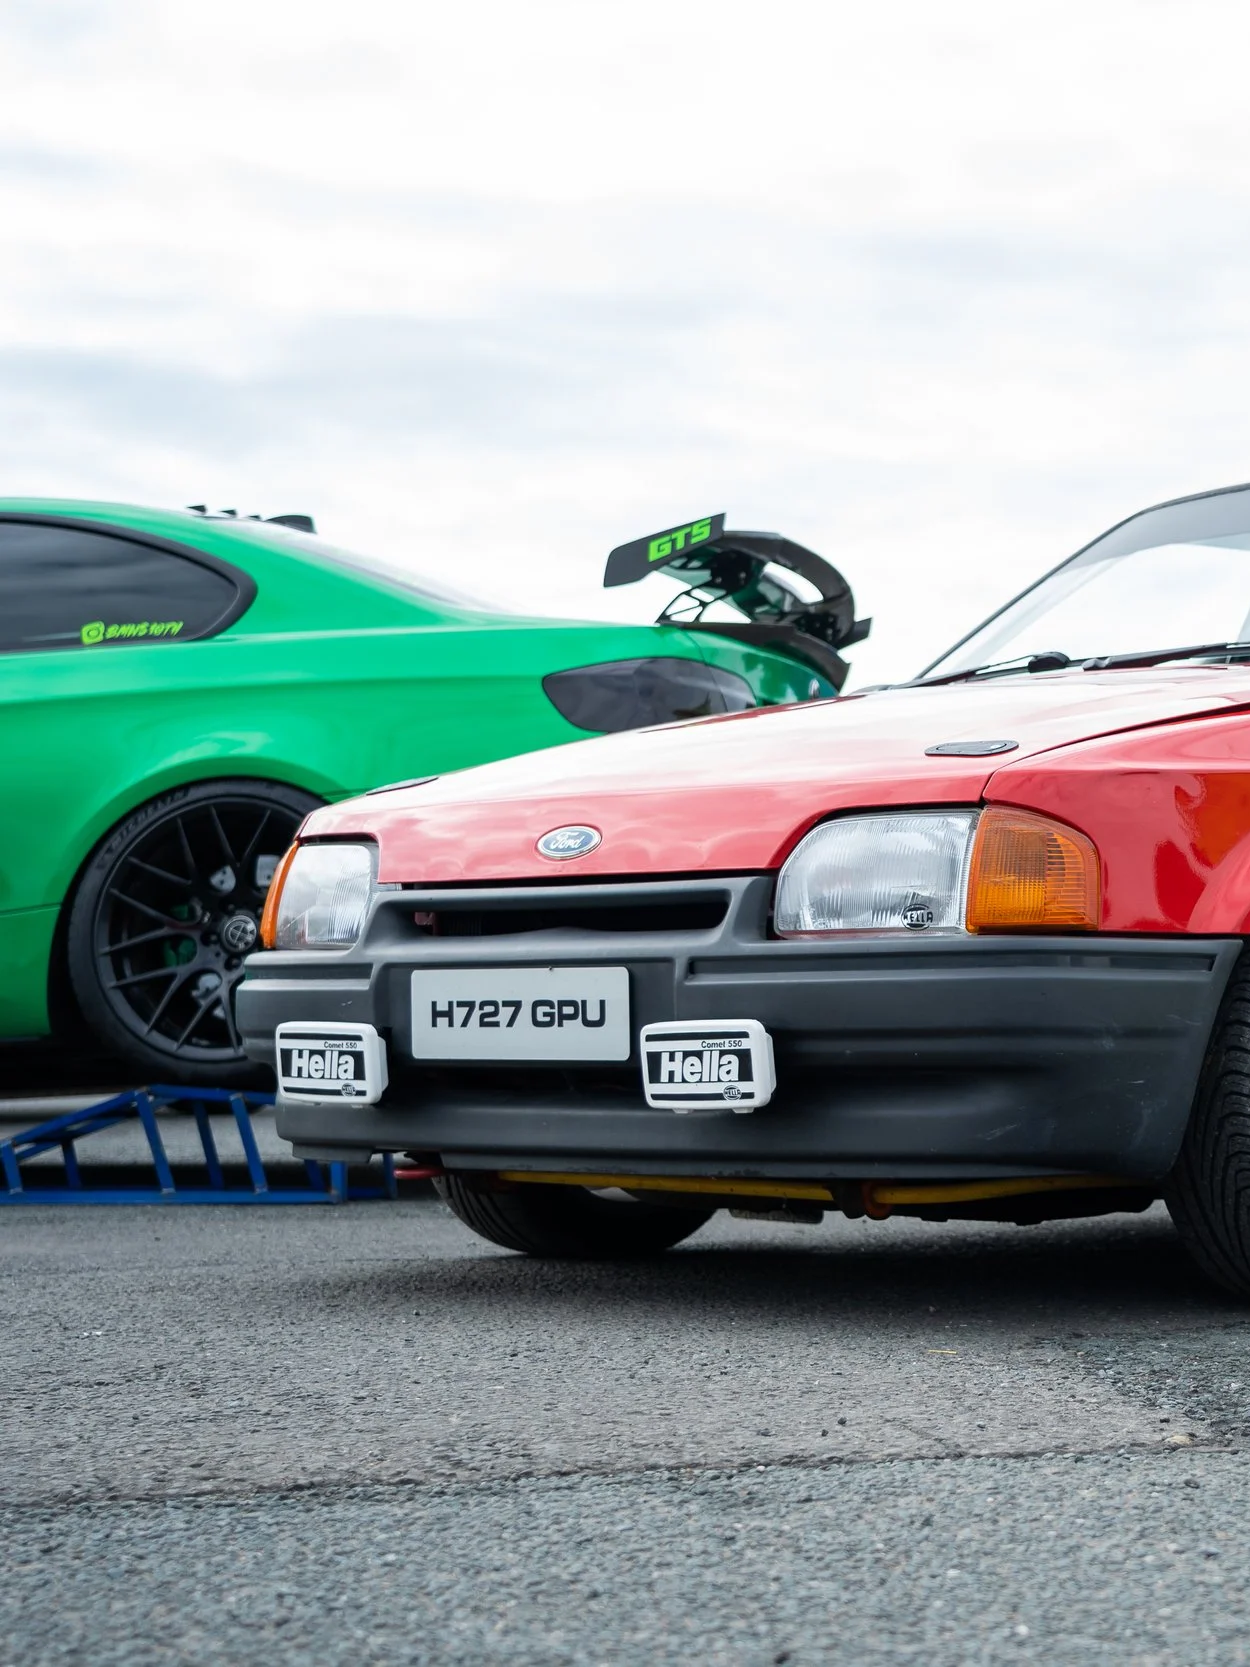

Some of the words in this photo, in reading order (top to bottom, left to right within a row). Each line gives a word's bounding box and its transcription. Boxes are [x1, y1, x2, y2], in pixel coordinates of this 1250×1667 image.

[648, 518, 712, 563] GTS
[550, 831, 586, 850] Ford
[903, 911, 934, 924] HELLA
[431, 1000, 522, 1028] H727
[531, 999, 606, 1028] GPU
[324, 1041, 344, 1049] Comet
[701, 1040, 726, 1049] Comet
[728, 1040, 743, 1048] 550
[291, 1049, 355, 1080] Hella
[660, 1050, 740, 1083] Hella
